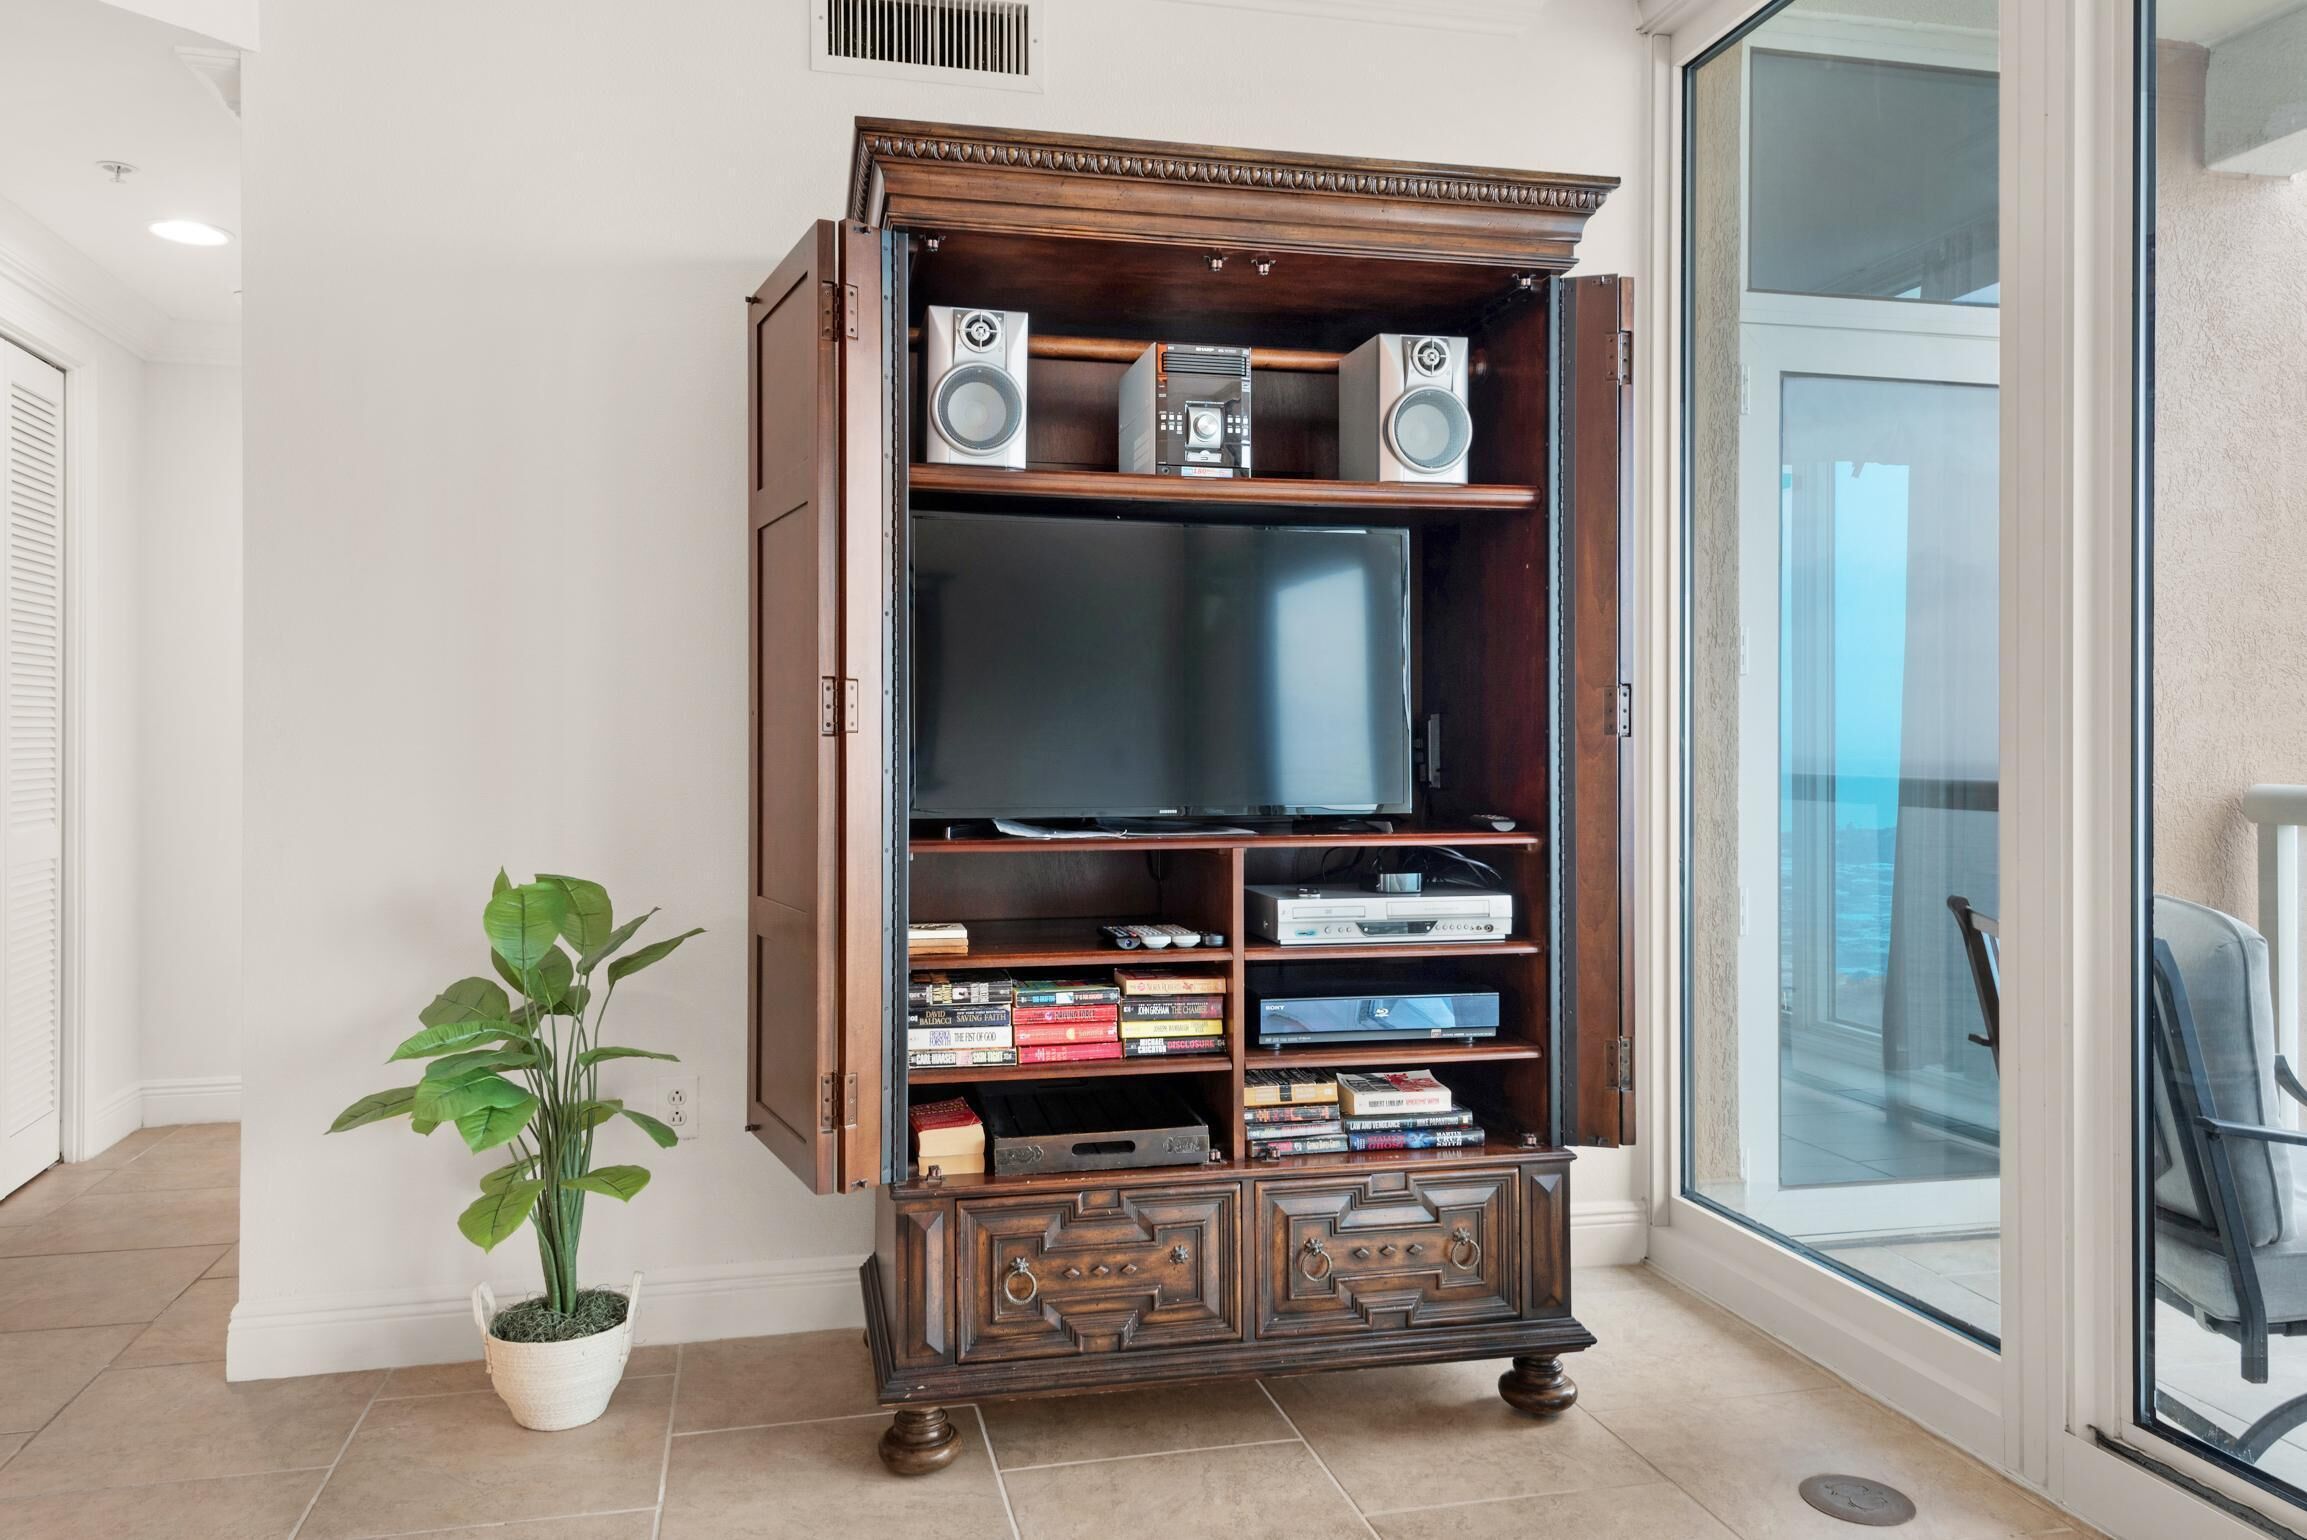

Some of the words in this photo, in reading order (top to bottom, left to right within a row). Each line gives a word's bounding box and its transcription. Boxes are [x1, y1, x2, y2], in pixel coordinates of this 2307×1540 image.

[1138, 1005, 1150, 1015] JOHN
[1150, 1005, 1170, 1015] GRISHAM
[1172, 1006, 1182, 1014] THE
[1182, 1005, 1208, 1014] CHAMBER
[920, 1017, 951, 1025] BALDACCI
[957, 1014, 981, 1023] SAVING
[985, 1013, 1006, 1021] FAITH
[954, 1032, 964, 1042] THE
[965, 1032, 975, 1042] FIST
[976, 1031, 983, 1041] OF
[984, 1031, 997, 1041] GOD
[1139, 1038, 1164, 1046] MICHAEL
[1167, 1040, 1214, 1048] DISCLOSURE
[1138, 1046, 1167, 1054] CRICHTON
[916, 1053, 931, 1065] CARL
[1350, 1121, 1361, 1130] LAW
[1361, 1121, 1373, 1129] AND
[1372, 1120, 1401, 1129] VENGEANCE
[1416, 1118, 1429, 1127] MIKE
[1367, 1142, 1405, 1150] GHOST
